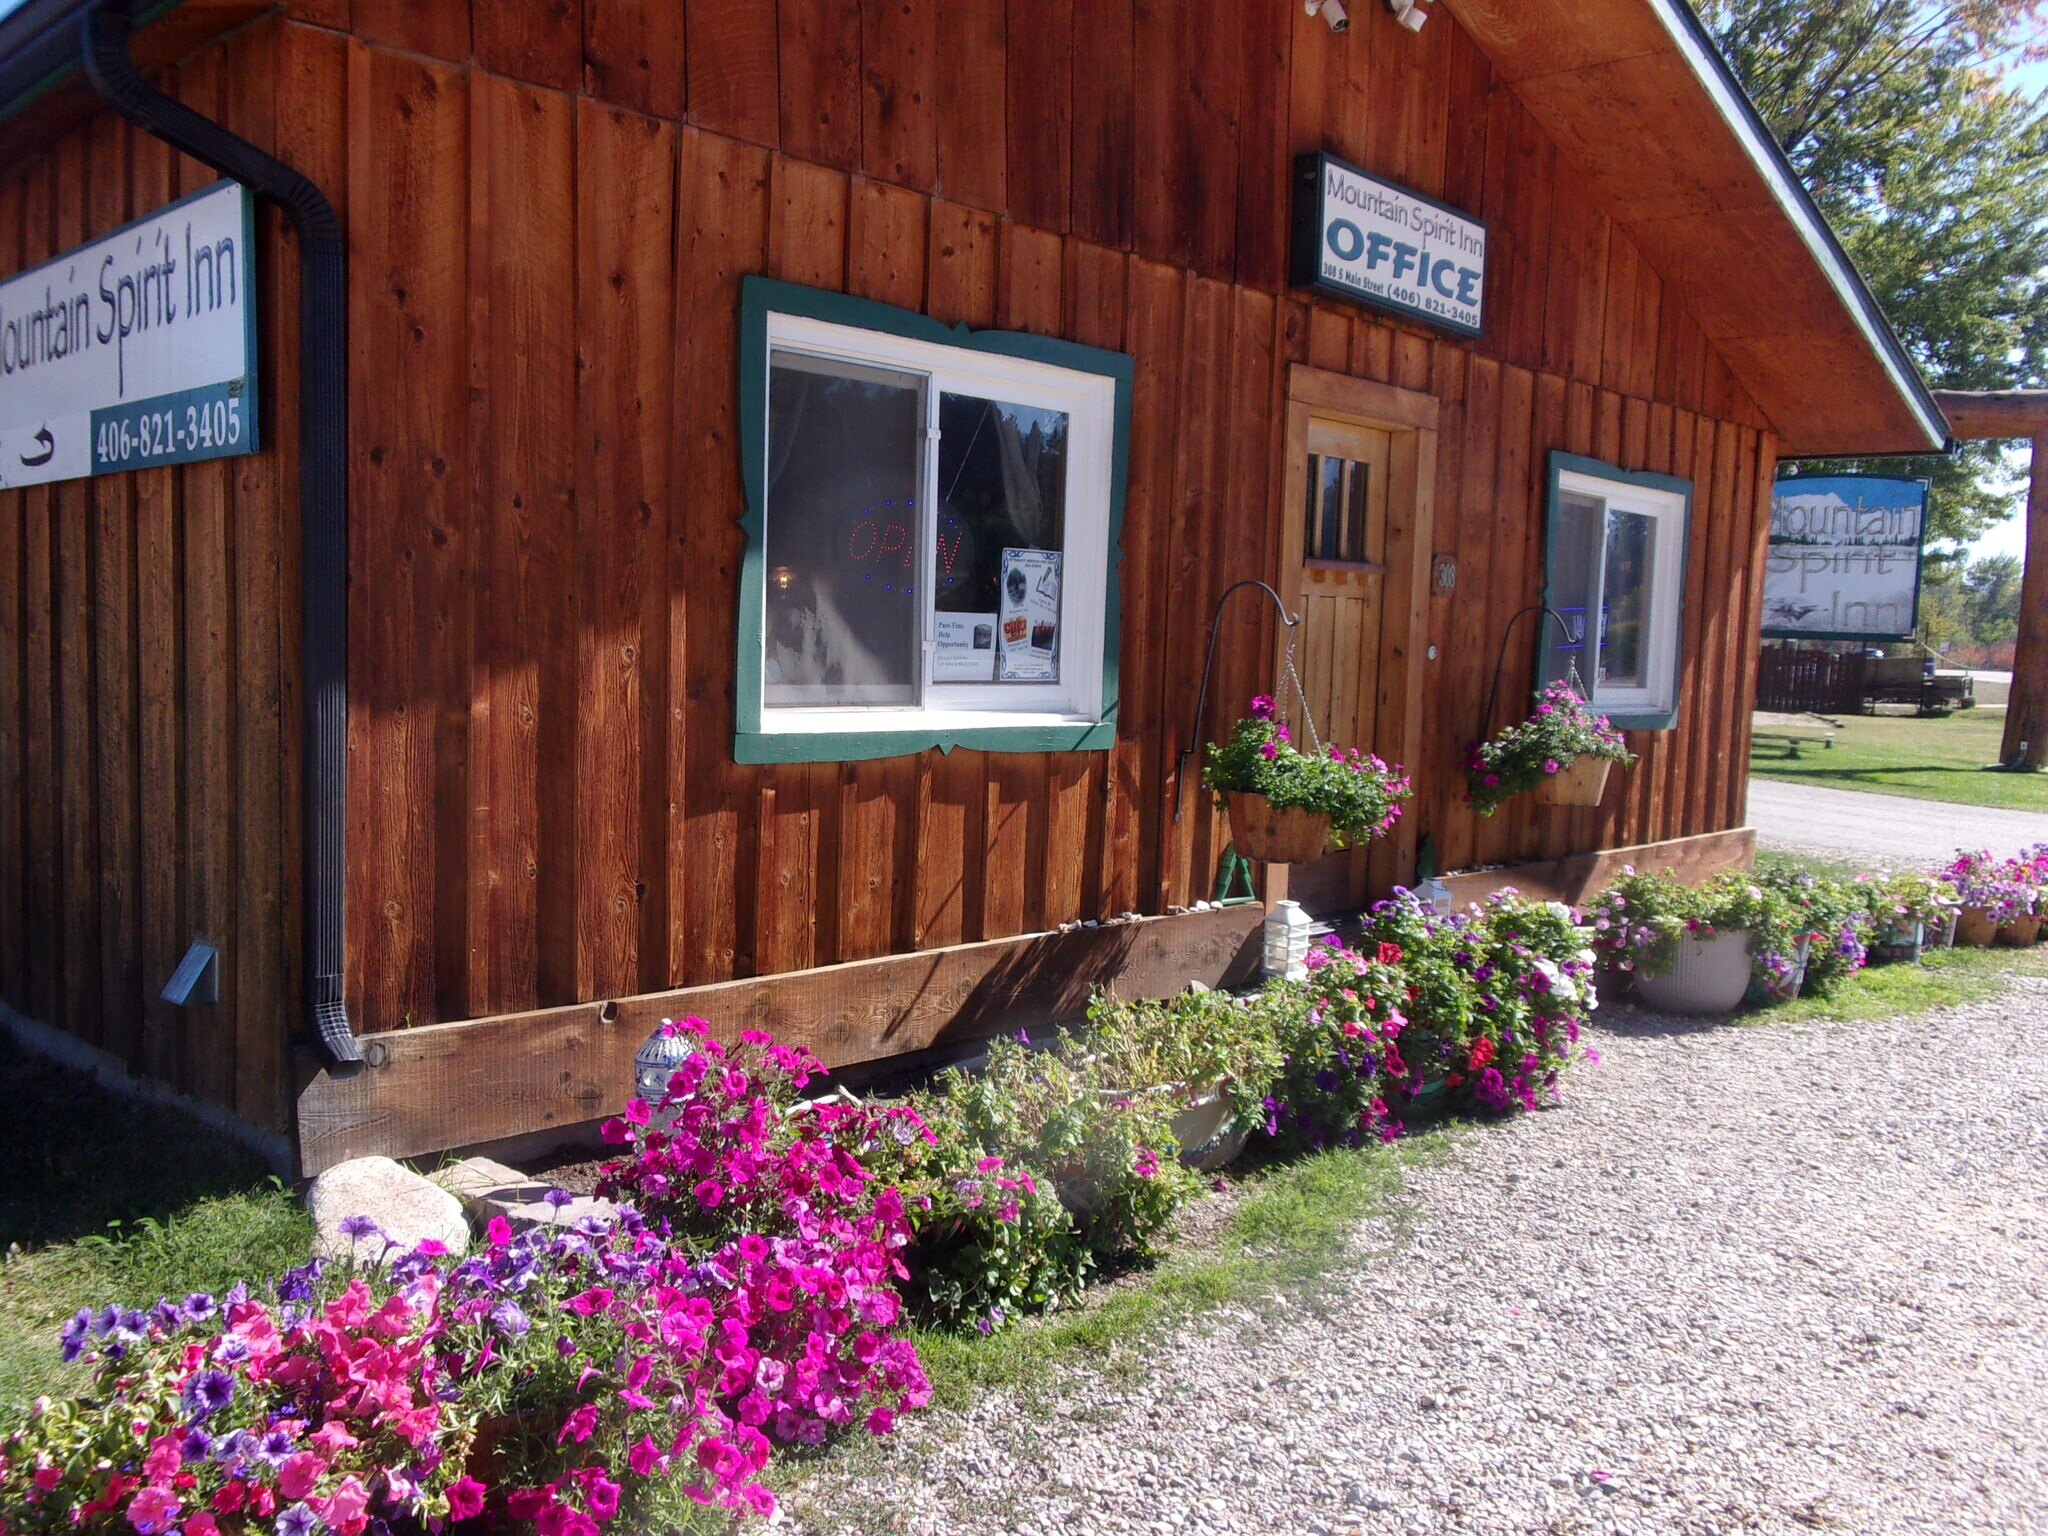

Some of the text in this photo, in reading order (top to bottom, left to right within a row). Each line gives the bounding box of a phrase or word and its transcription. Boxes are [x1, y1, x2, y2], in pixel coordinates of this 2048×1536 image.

[1327, 169, 1482, 257] Mountain Spirit Inn
[1326, 218, 1482, 307] OFFICE
[0, 221, 236, 398] ountain Spirit Inn
[1323, 262, 1478, 326] 308 S Main Street (406) 821-3405
[97, 397, 241, 463] 406-821-3405
[1439, 563, 1456, 588] 308
[1767, 541, 1897, 594] Spirit
[938, 621, 965, 630] Part-Time
[938, 631, 951, 639] Help
[1830, 590, 1900, 629] Inn
